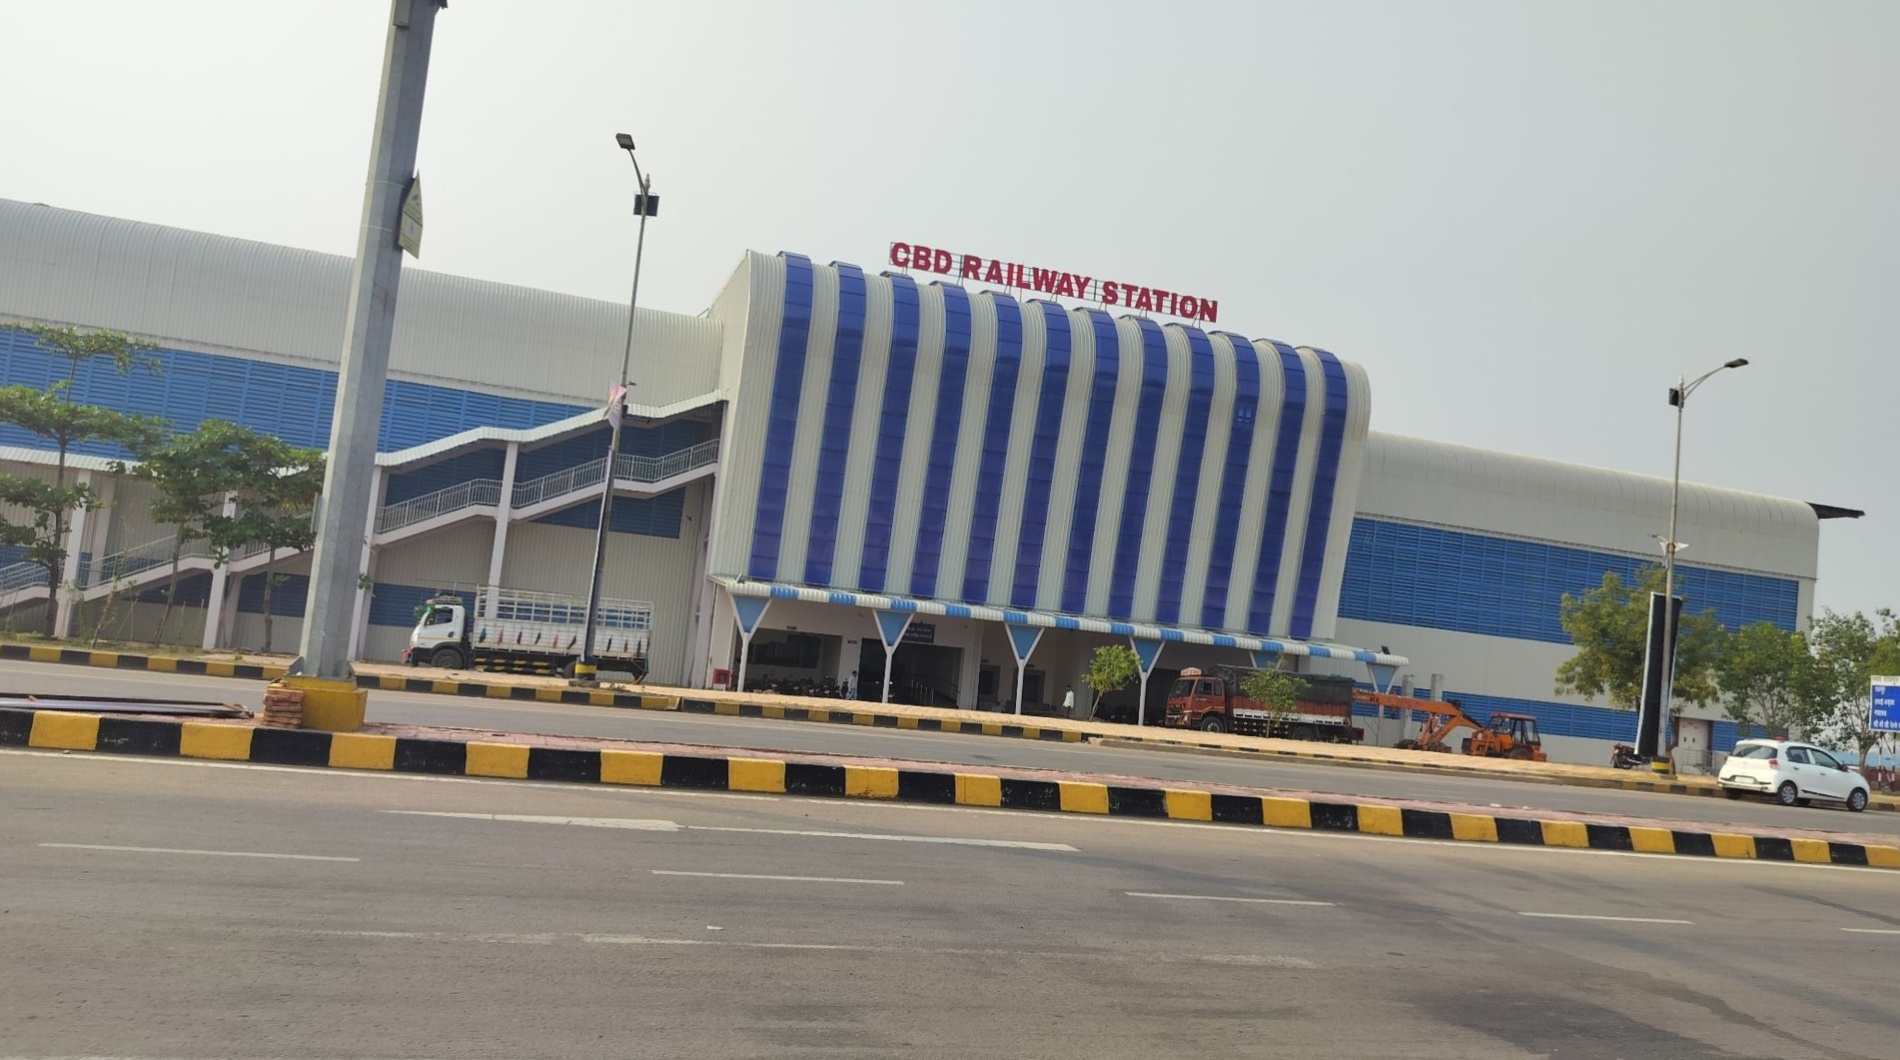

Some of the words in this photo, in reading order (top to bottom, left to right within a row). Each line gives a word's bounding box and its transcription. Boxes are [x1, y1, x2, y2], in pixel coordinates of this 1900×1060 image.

[891, 242, 952, 274] CBD
[963, 254, 1091, 299] RAILWAY
[1102, 281, 1218, 323] STATION
